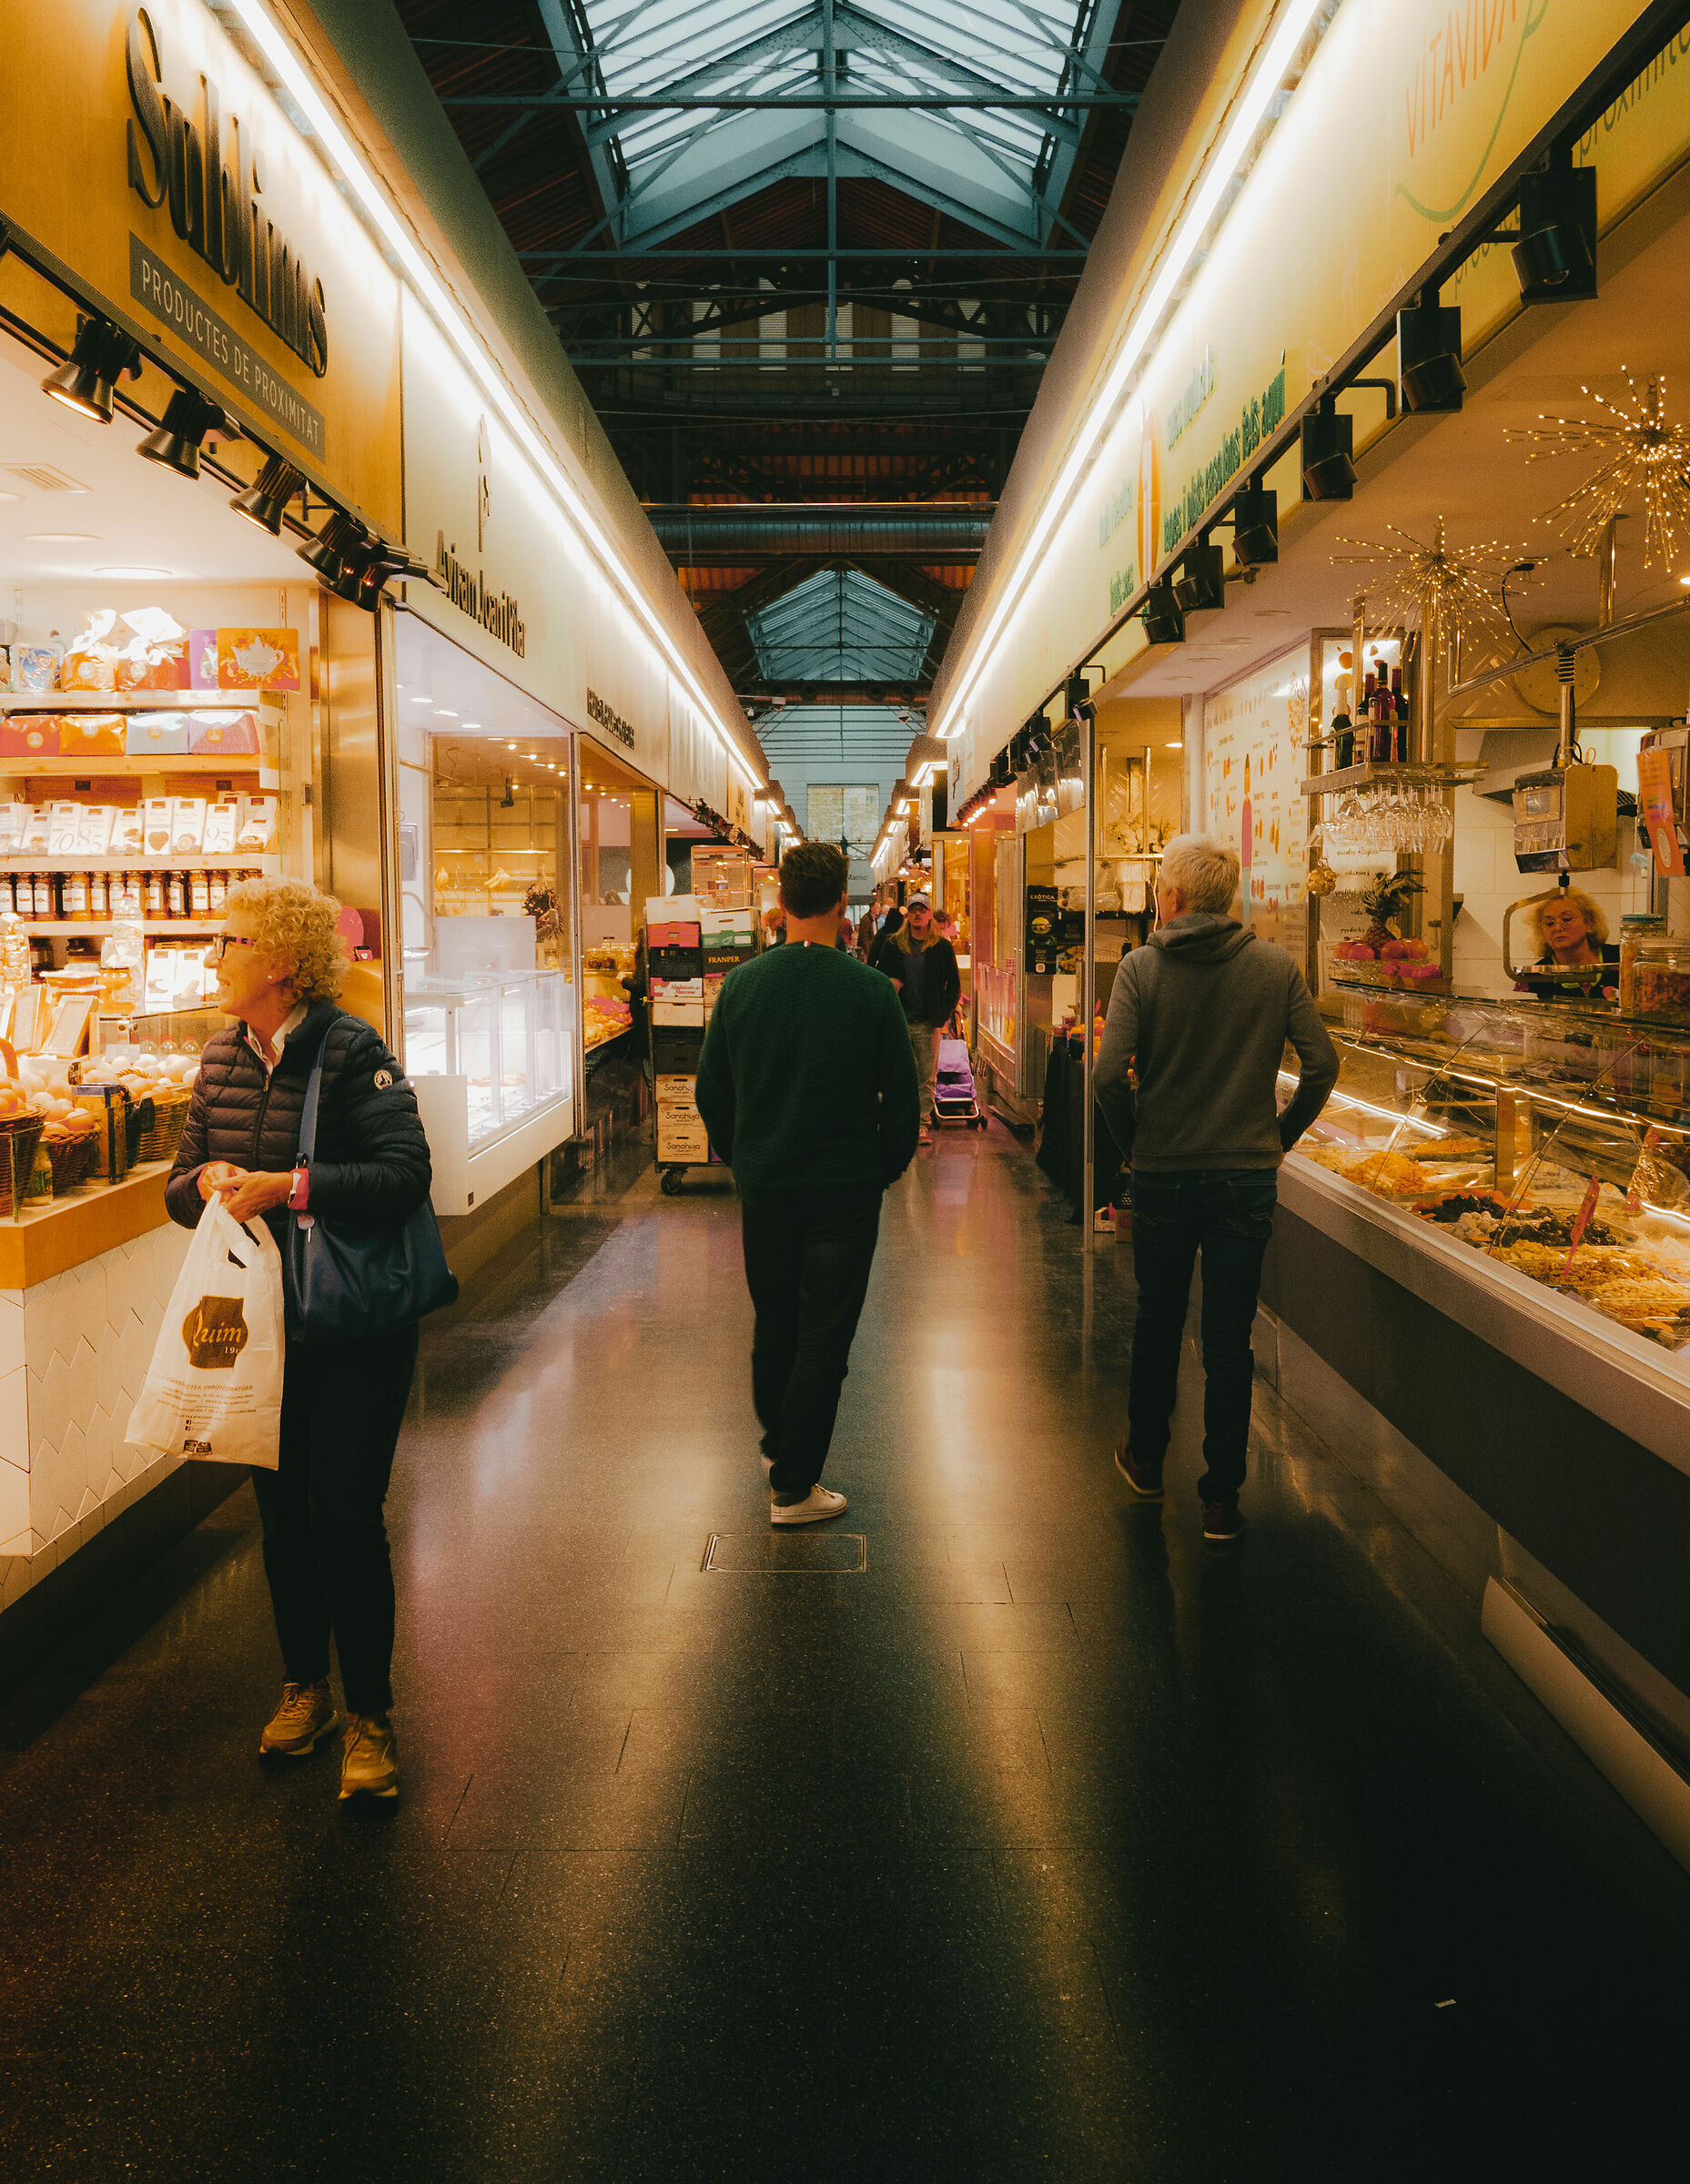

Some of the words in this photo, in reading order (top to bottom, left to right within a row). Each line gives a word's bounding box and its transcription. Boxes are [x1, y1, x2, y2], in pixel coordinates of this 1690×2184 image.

[126, 2, 327, 379] Sublims
[142, 259, 228, 364] PRODUCTES
[234, 346, 250, 384] DE
[255, 366, 319, 445] PROXIMITAT
[708, 956, 740, 964] FRANPER
[666, 1141, 701, 1151] Sanahuja
